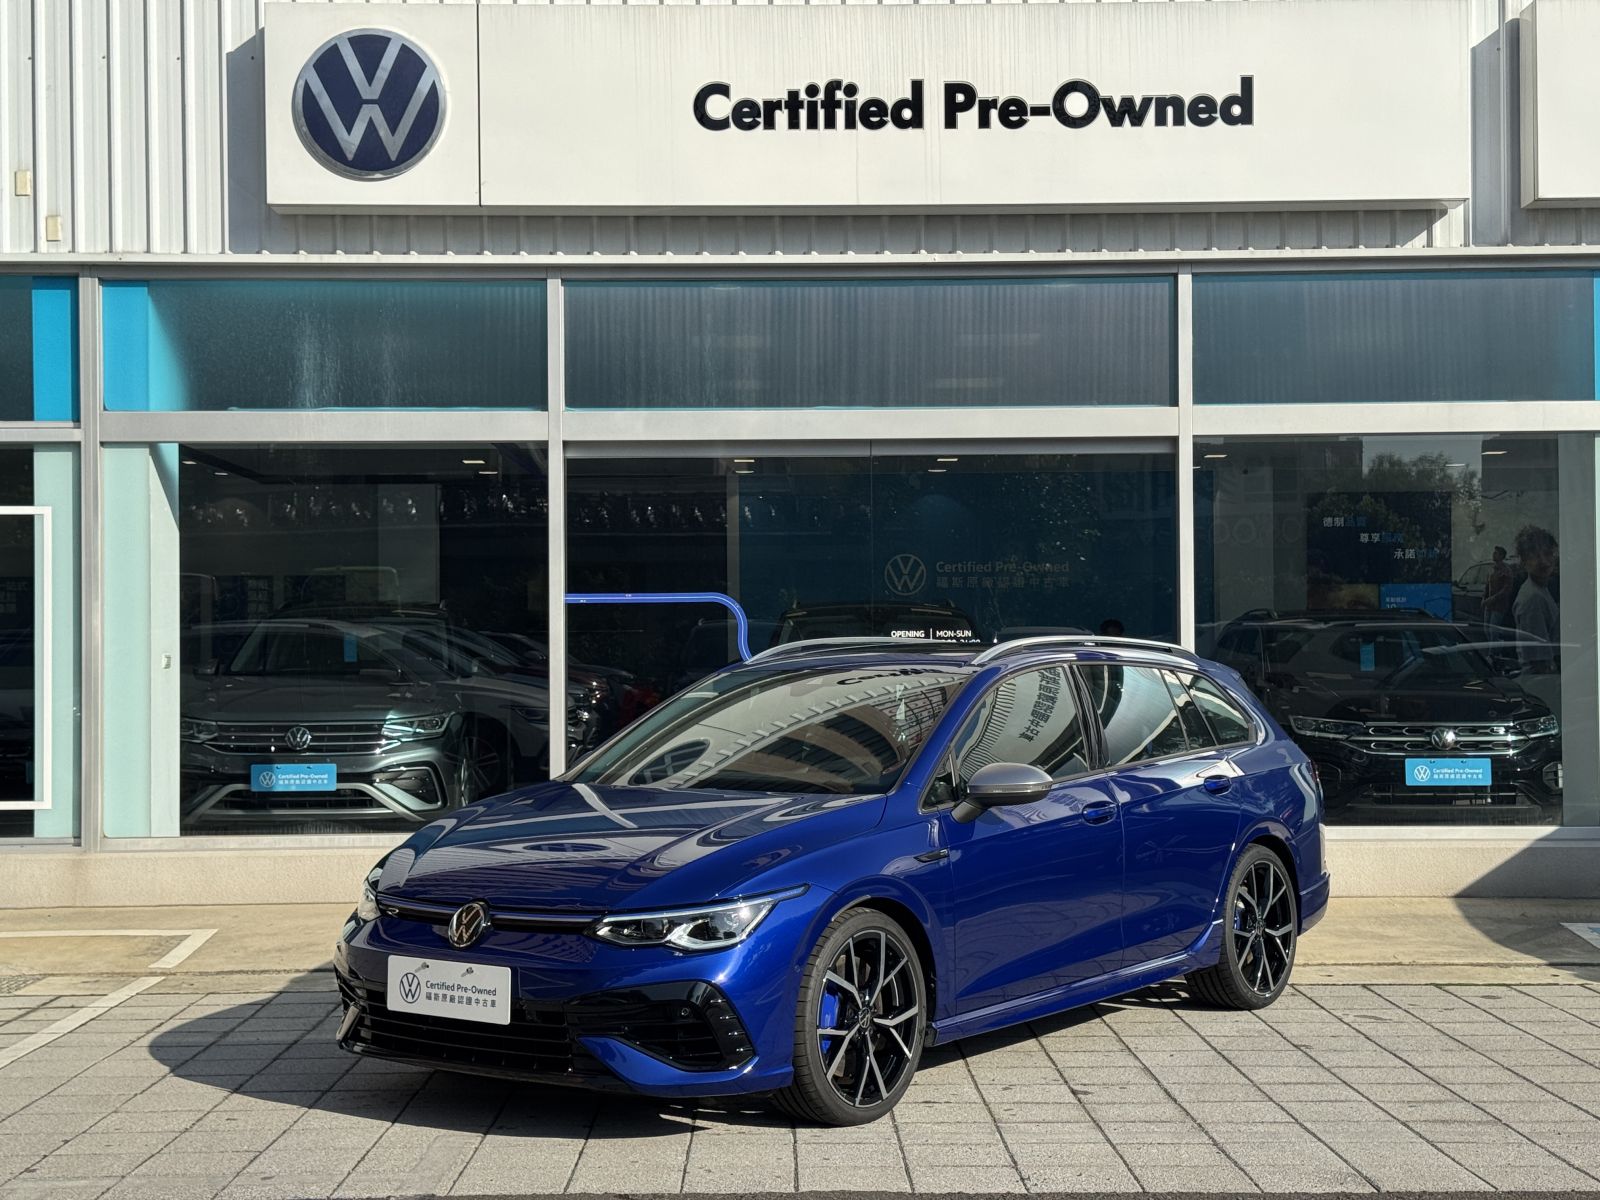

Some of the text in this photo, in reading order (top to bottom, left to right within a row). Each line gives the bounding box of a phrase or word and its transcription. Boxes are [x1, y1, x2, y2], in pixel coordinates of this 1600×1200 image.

[694, 75, 1254, 131] Certified Pre-Owned
[936, 561, 1070, 573] Certified Pre-Owned
[891, 630, 925, 638] OPENING
[936, 629, 972, 637] MON-SUN
[425, 980, 497, 996] Certified Pre-Owned
